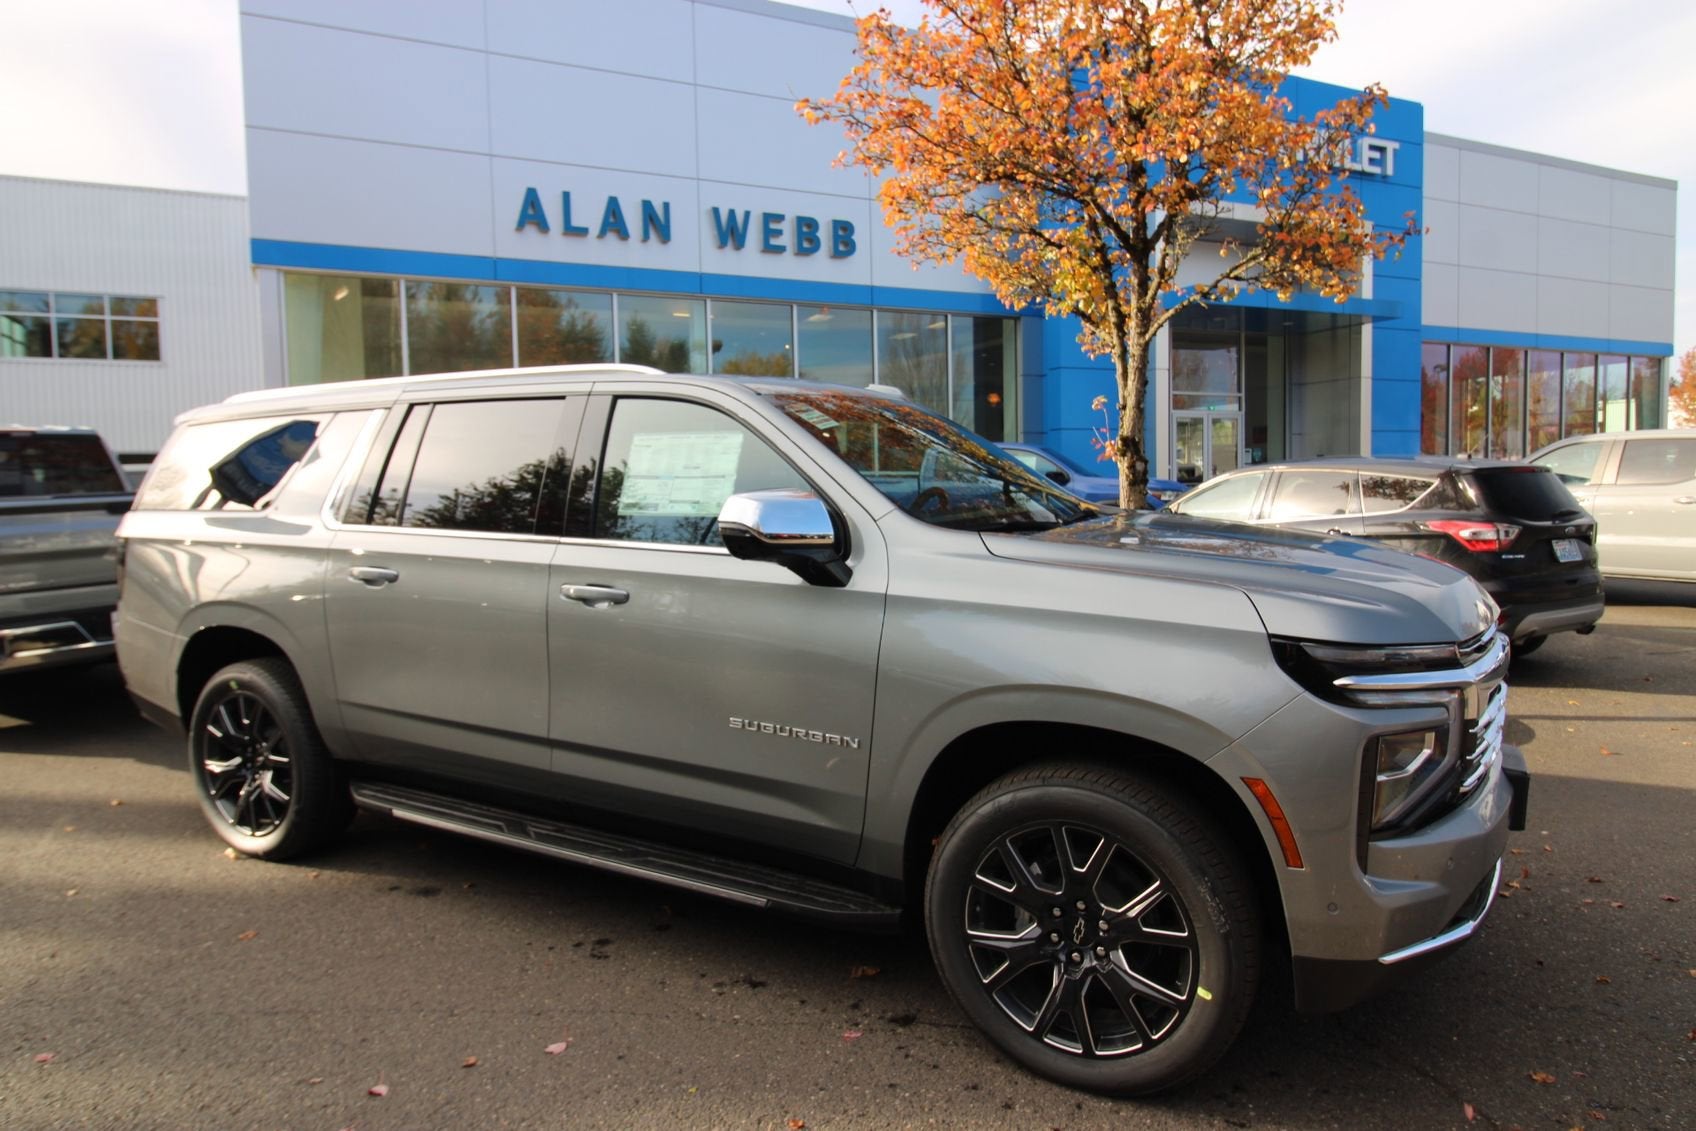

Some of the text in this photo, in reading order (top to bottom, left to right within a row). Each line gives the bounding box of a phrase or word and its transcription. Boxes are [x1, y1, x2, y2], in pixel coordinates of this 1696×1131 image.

[515, 187, 857, 259] ALAN WEBB
[729, 716, 860, 749] SUBURBAN
